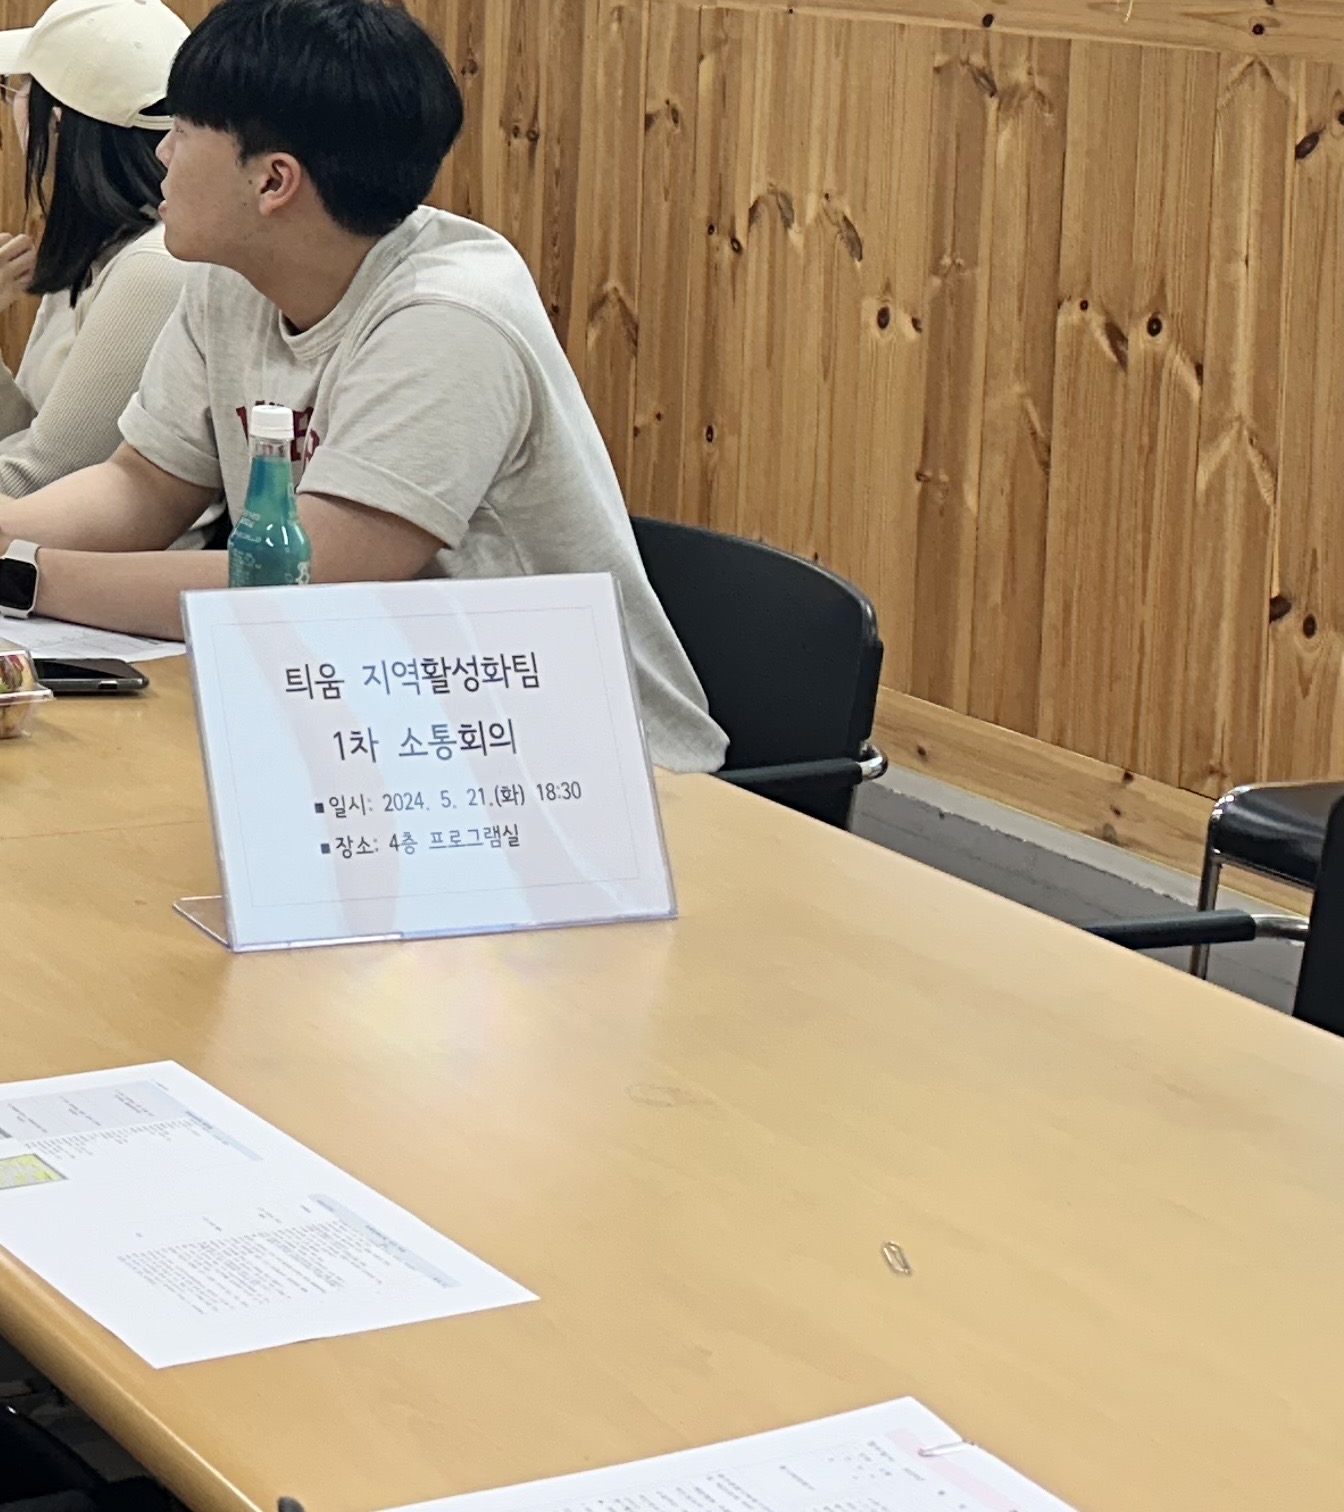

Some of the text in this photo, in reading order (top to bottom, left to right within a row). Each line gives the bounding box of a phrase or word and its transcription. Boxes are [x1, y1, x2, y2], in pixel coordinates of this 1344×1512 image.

[284, 651, 541, 701] 틔움 지역활성화팀
[333, 718, 518, 764] 1차 소통회의
[328, 781, 583, 819] 일시: 2024. 5. 21.(화) 18:30
[335, 823, 521, 860] 장소: 4층 프로그램실
